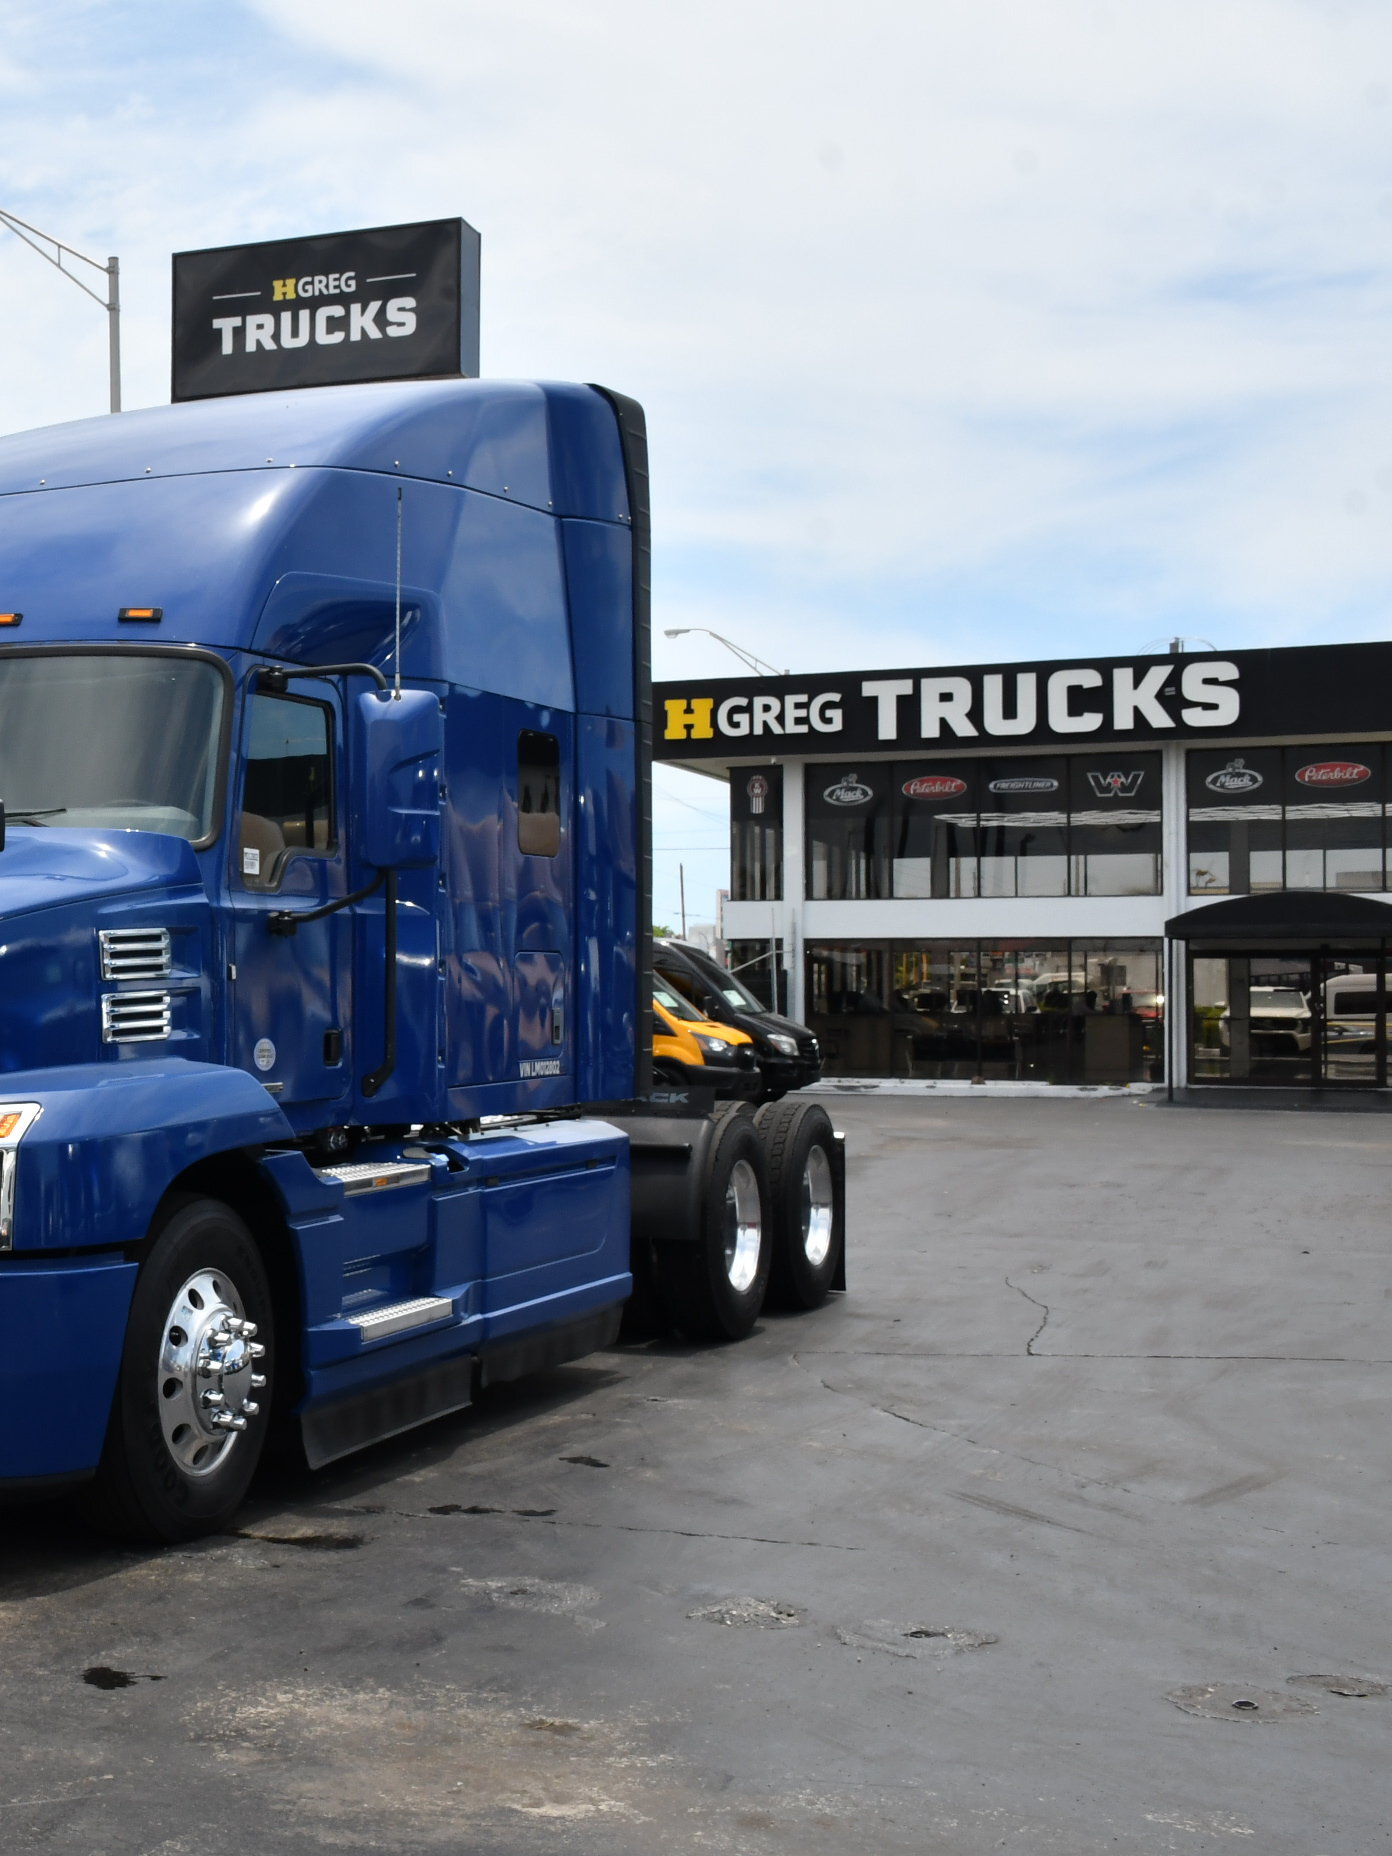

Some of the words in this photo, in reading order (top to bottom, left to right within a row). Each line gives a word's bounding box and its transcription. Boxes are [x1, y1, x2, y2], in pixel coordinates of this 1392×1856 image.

[212, 296, 417, 355] TRUCKS
[861, 661, 1241, 741] TRUCKS
[1215, 774, 1254, 789] Mack
[1304, 766, 1365, 782] Peterbilt
[831, 786, 864, 801] Mack
[909, 778, 963, 795] Peterbilt
[995, 781, 1052, 790] FREIGHTLINER
[519, 1061, 531, 1078] VIN
